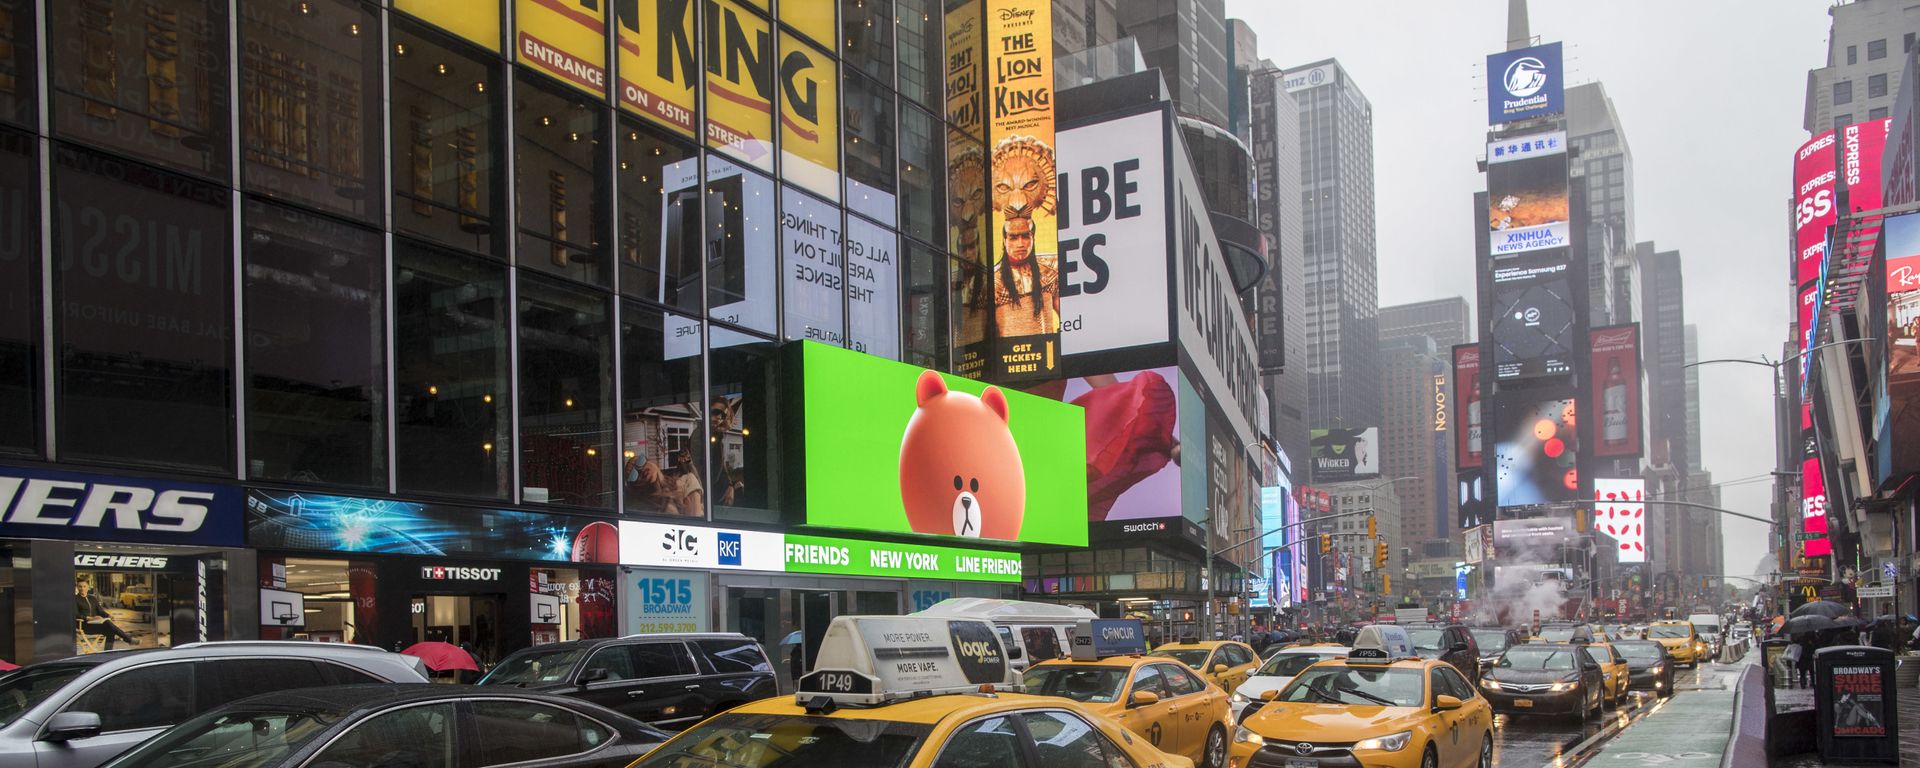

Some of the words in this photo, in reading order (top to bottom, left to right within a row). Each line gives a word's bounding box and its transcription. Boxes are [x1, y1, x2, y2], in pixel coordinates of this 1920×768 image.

[999, 8, 1034, 20] Disney
[1002, 34, 1034, 51] THE
[998, 57, 1041, 83] LION
[525, 38, 603, 87] ENTRANCE
[626, 86, 648, 107] ON
[657, 101, 690, 126] 45TH
[708, 124, 746, 150] STREET
[1504, 94, 1547, 109] Prudential
[995, 86, 1050, 118] KING
[1253, 102, 1273, 200] TIMES
[1846, 126, 1860, 186] EXPRESS
[1082, 158, 1141, 226] BE
[1508, 229, 1552, 243] XINHUA
[1498, 241, 1524, 252] NEWS
[1526, 236, 1564, 248] AGENCY
[1179, 178, 1203, 338] WE
[1204, 243, 1224, 378] CAN
[1495, 270, 1528, 279] Experience
[1528, 266, 1556, 274] Samsung
[1012, 344, 1032, 352] GET
[1002, 352, 1042, 363] TICKETS
[1008, 364, 1036, 374] HERE!
[1434, 374, 1446, 431] NOVOTEL
[1124, 522, 1158, 532] swatch
[720, 540, 740, 558] RKF
[786, 544, 850, 566] FRIENDS
[870, 549, 902, 568] NEW
[906, 552, 939, 571] YORK
[956, 556, 980, 572] LINE
[982, 557, 1022, 576] FRIENDS
[444, 567, 502, 580] TISSOT
[638, 578, 691, 604] 1515
[644, 604, 691, 614] BROADWAY
[640, 623, 696, 634] 212.599.3700
[884, 633, 904, 643] MORE
[906, 633, 932, 643] POWER.
[957, 635, 996, 664] logic.
[897, 662, 918, 672] MORE
[920, 662, 938, 672] VAPE.
[820, 673, 852, 692] 1P49
[1834, 675, 1881, 684] SURE
[1834, 684, 1882, 692] THING
[1834, 726, 1886, 734] CHICAGO
